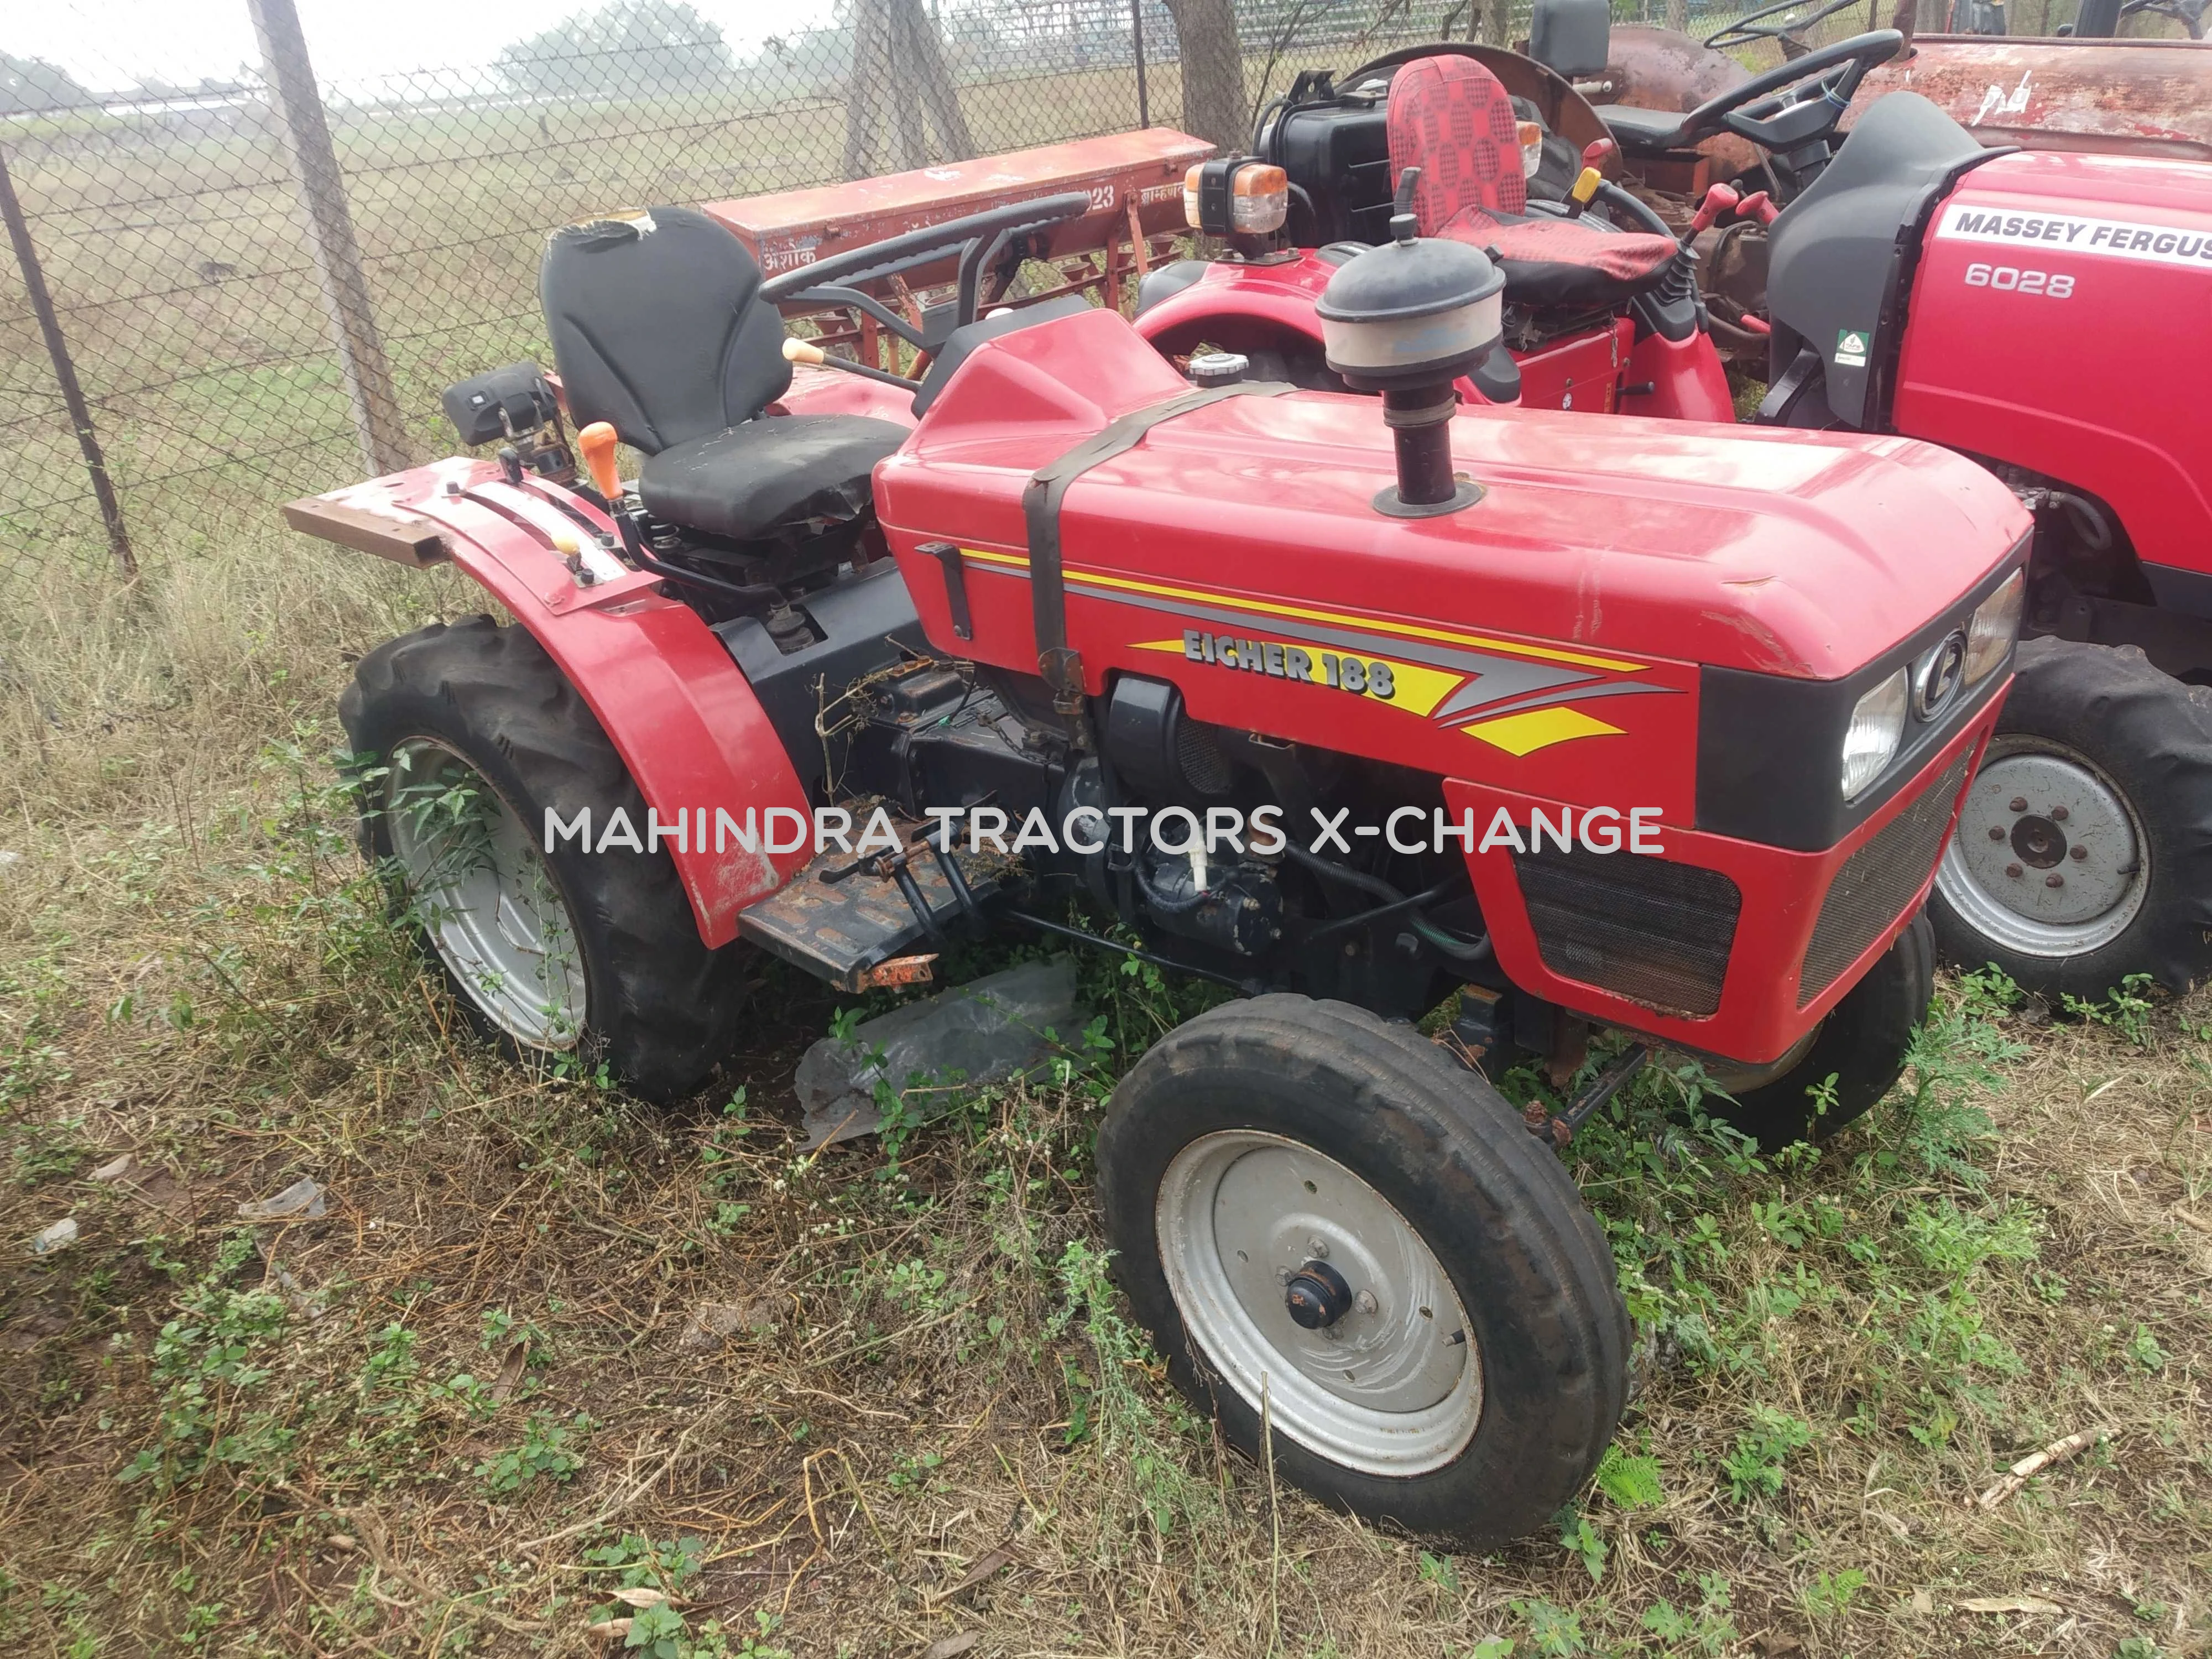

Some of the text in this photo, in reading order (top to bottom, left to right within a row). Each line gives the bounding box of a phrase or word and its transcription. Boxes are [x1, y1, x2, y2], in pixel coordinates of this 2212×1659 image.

[1955, 212, 2086, 243] MASSEY
[1965, 263, 2075, 299] 6028
[1183, 629, 1395, 700] EICHER 188
